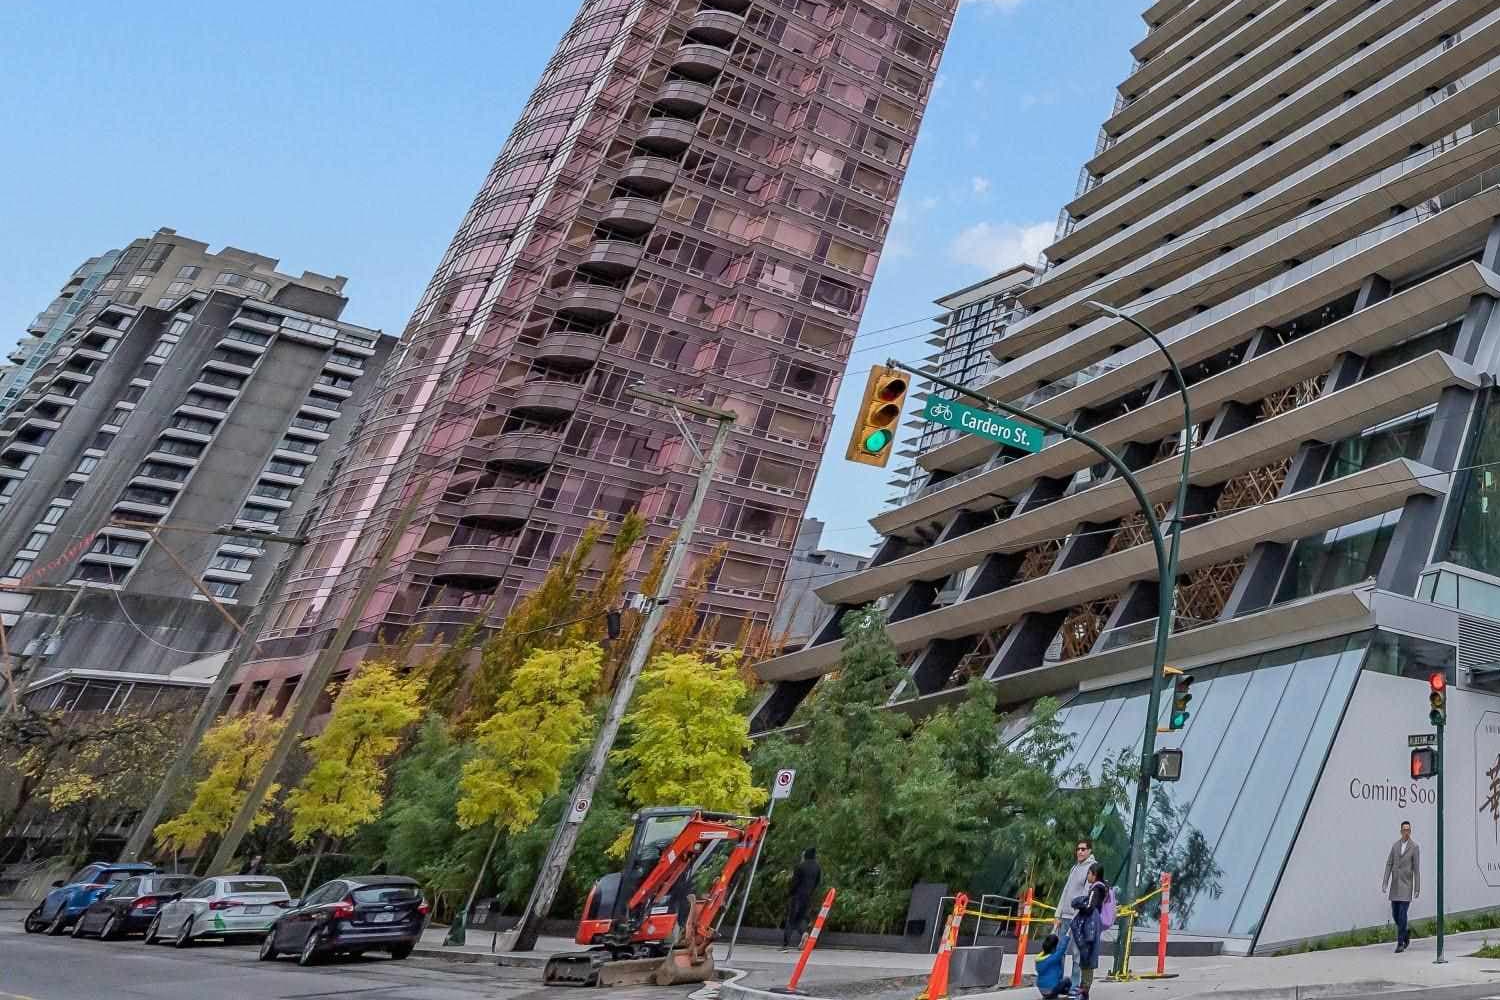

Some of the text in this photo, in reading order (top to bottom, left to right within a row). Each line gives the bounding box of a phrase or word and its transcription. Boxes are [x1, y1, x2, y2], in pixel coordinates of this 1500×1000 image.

[961, 410, 1031, 446] Cardero St.
[1349, 777, 1437, 809] Coming Soo
